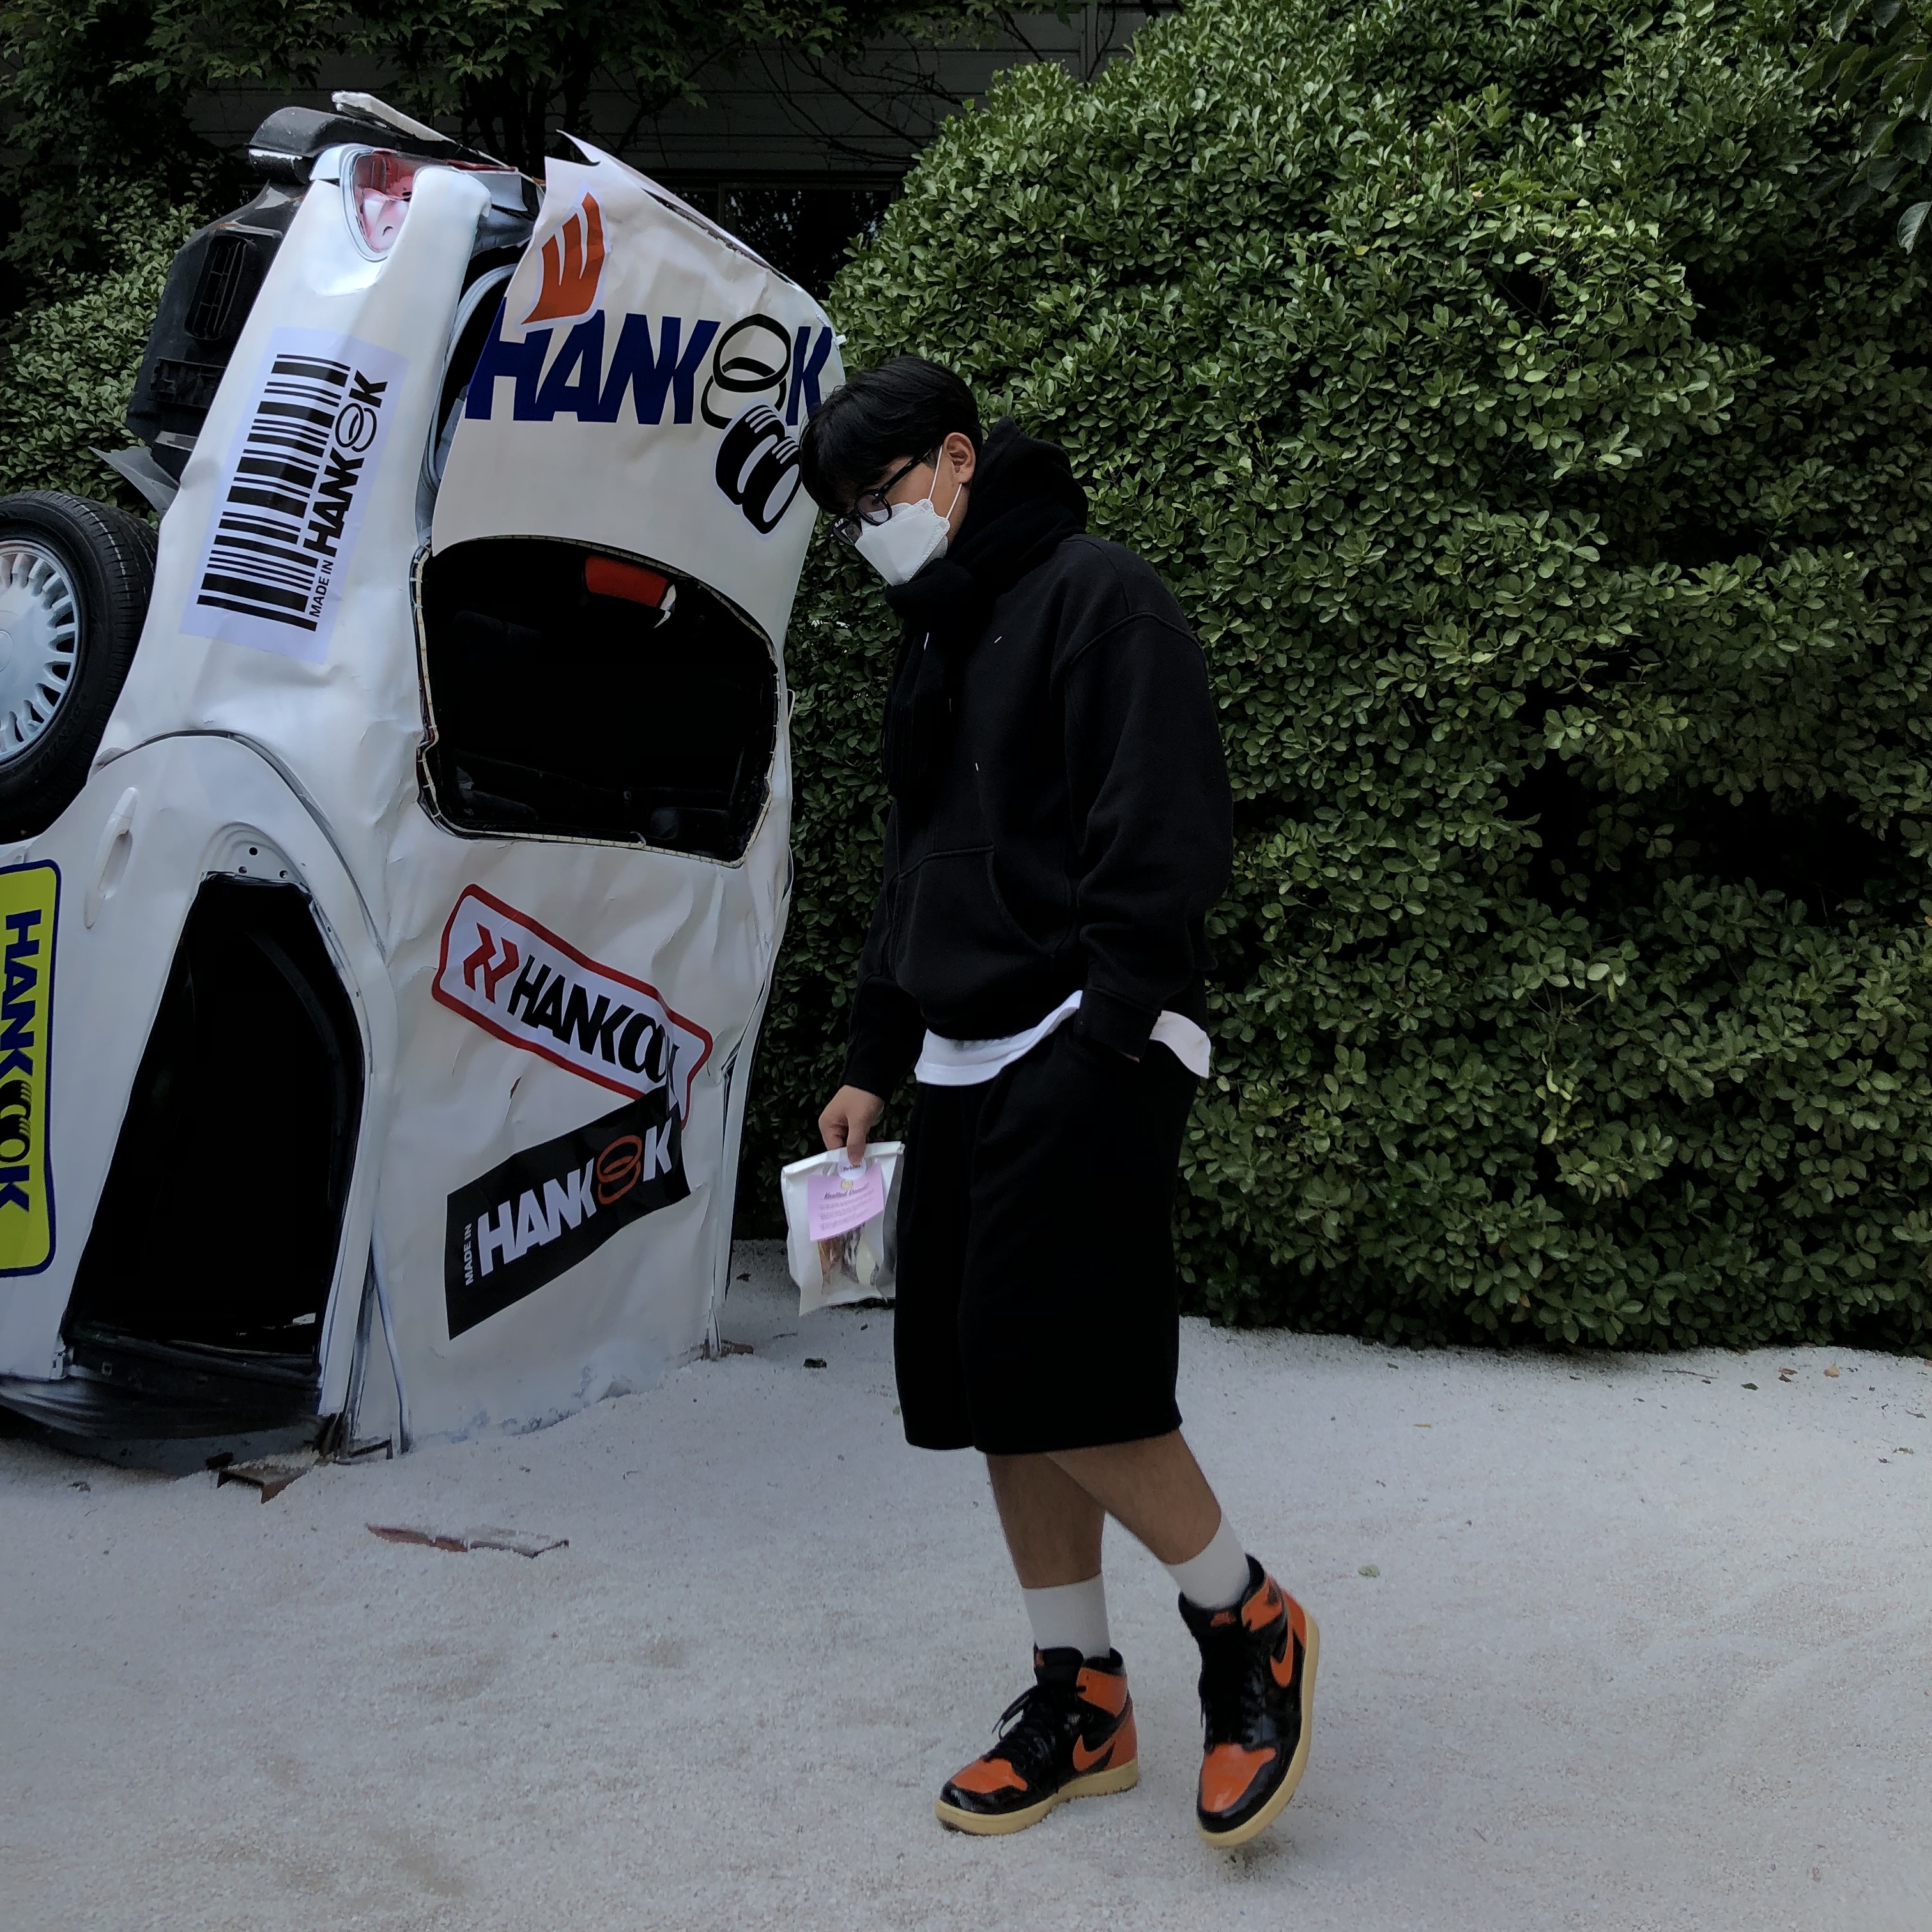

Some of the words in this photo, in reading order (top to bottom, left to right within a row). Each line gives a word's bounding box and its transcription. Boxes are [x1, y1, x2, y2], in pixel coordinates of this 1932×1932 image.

[309, 576, 330, 618] MADE
[321, 560, 334, 575] IN
[464, 1223, 472, 1241] IN
[464, 1241, 474, 1286] MADE
